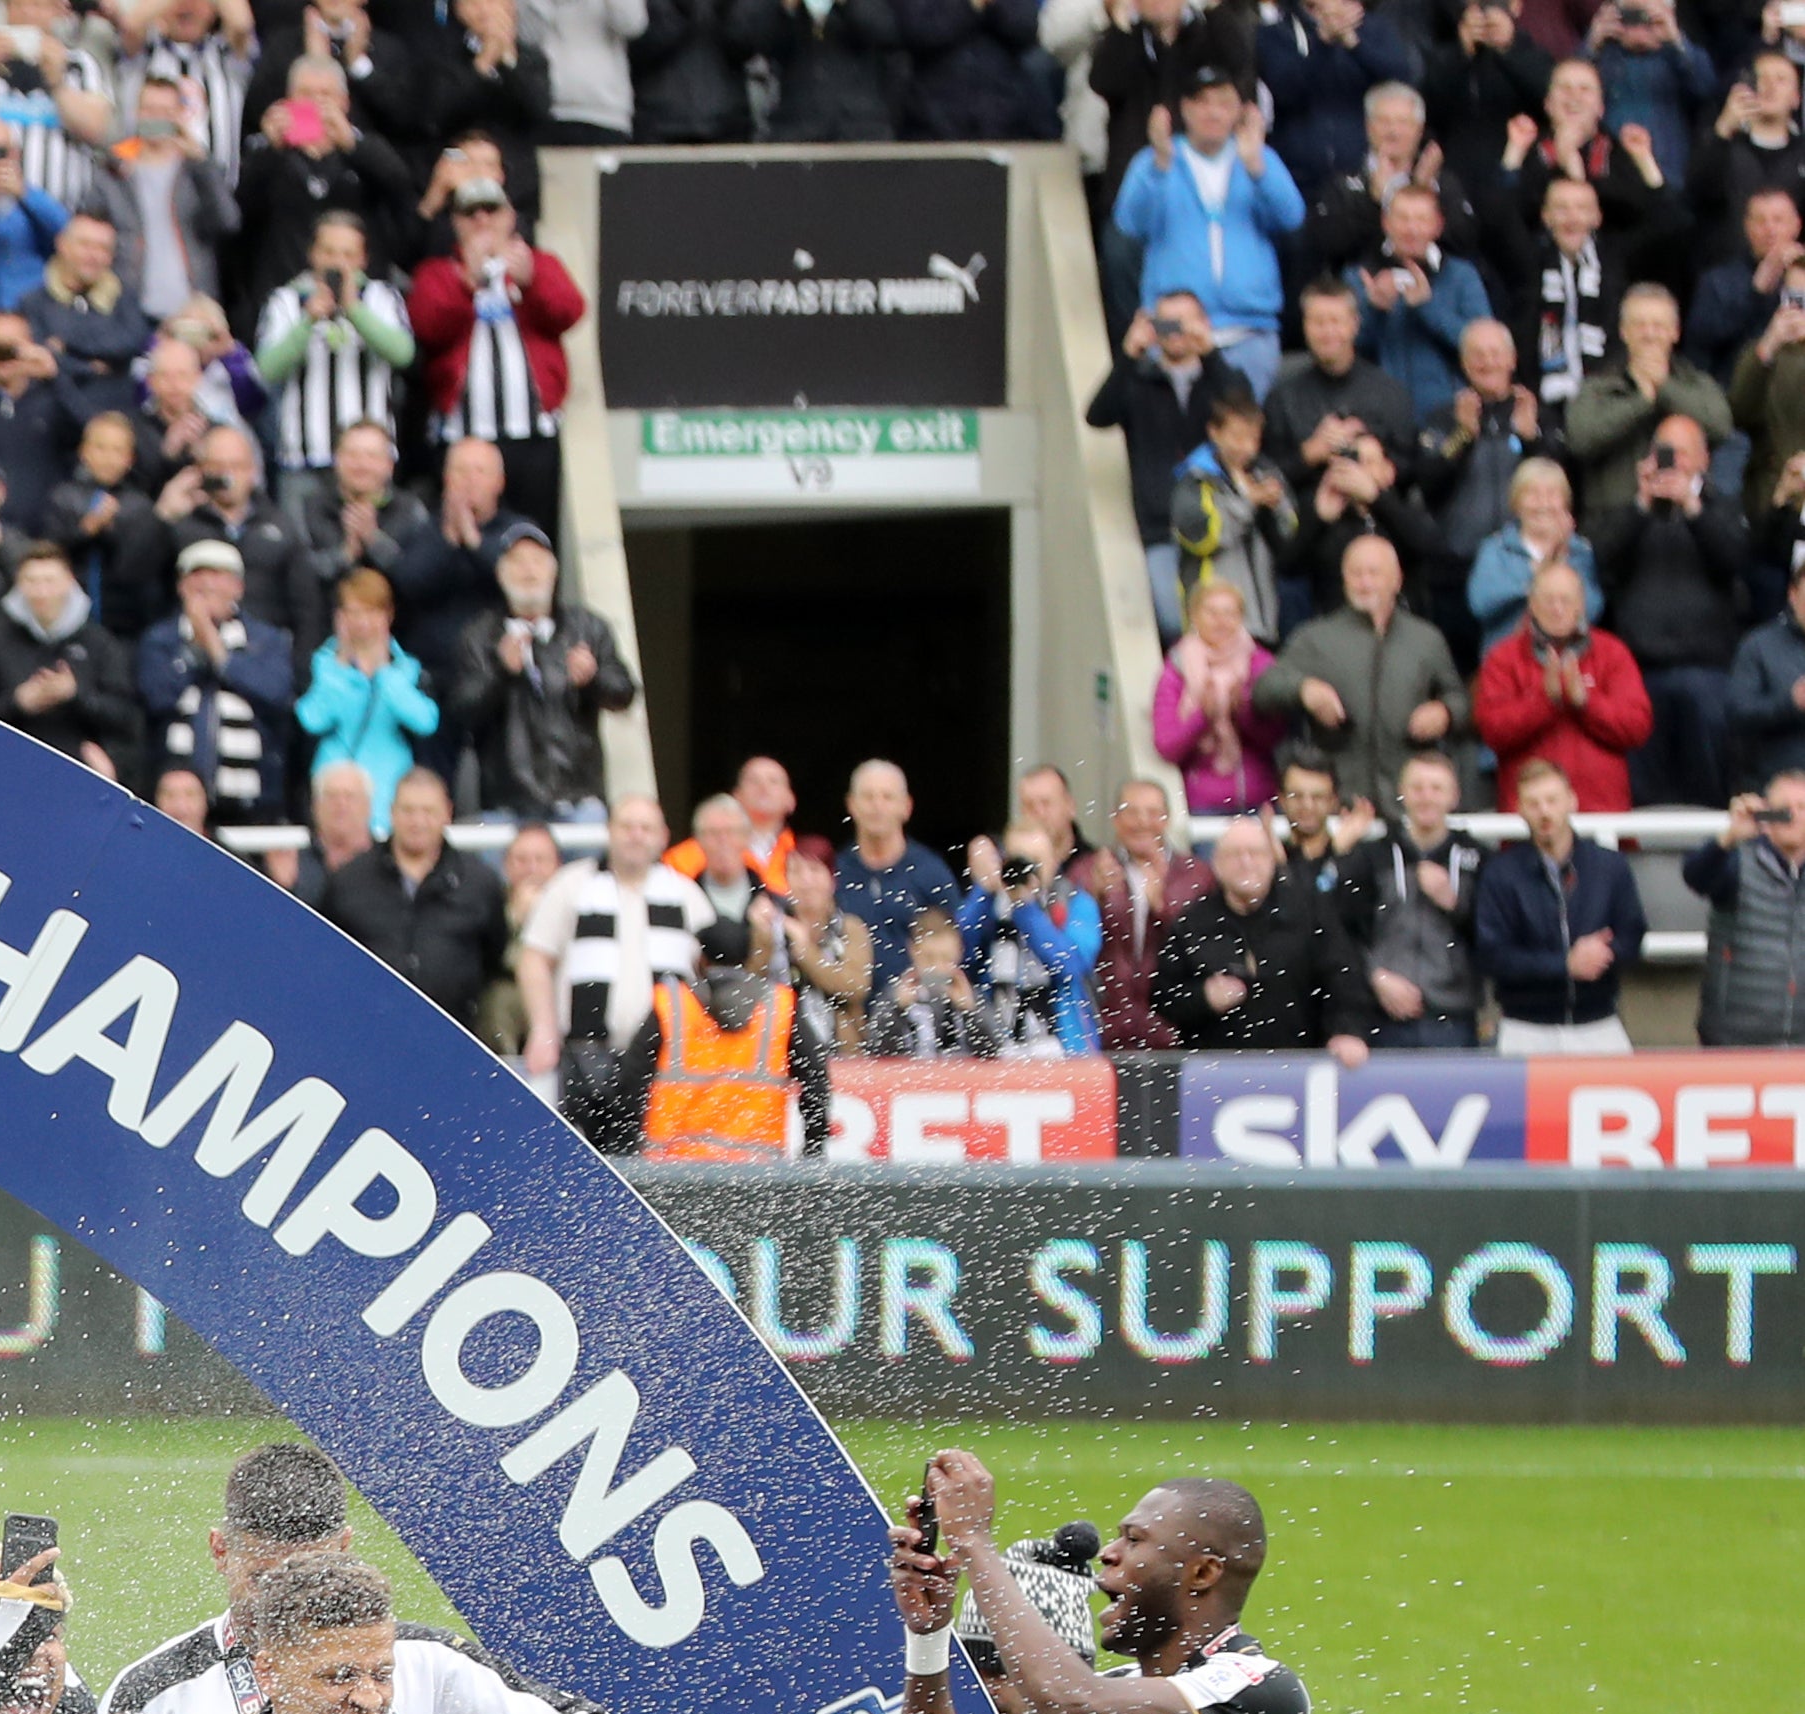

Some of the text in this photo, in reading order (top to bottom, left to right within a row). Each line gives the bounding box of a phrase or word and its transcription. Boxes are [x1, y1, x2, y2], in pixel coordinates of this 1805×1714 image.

[651, 412, 966, 454] Emergency exit
[1027, 1240, 1799, 1366] SUPPORT
